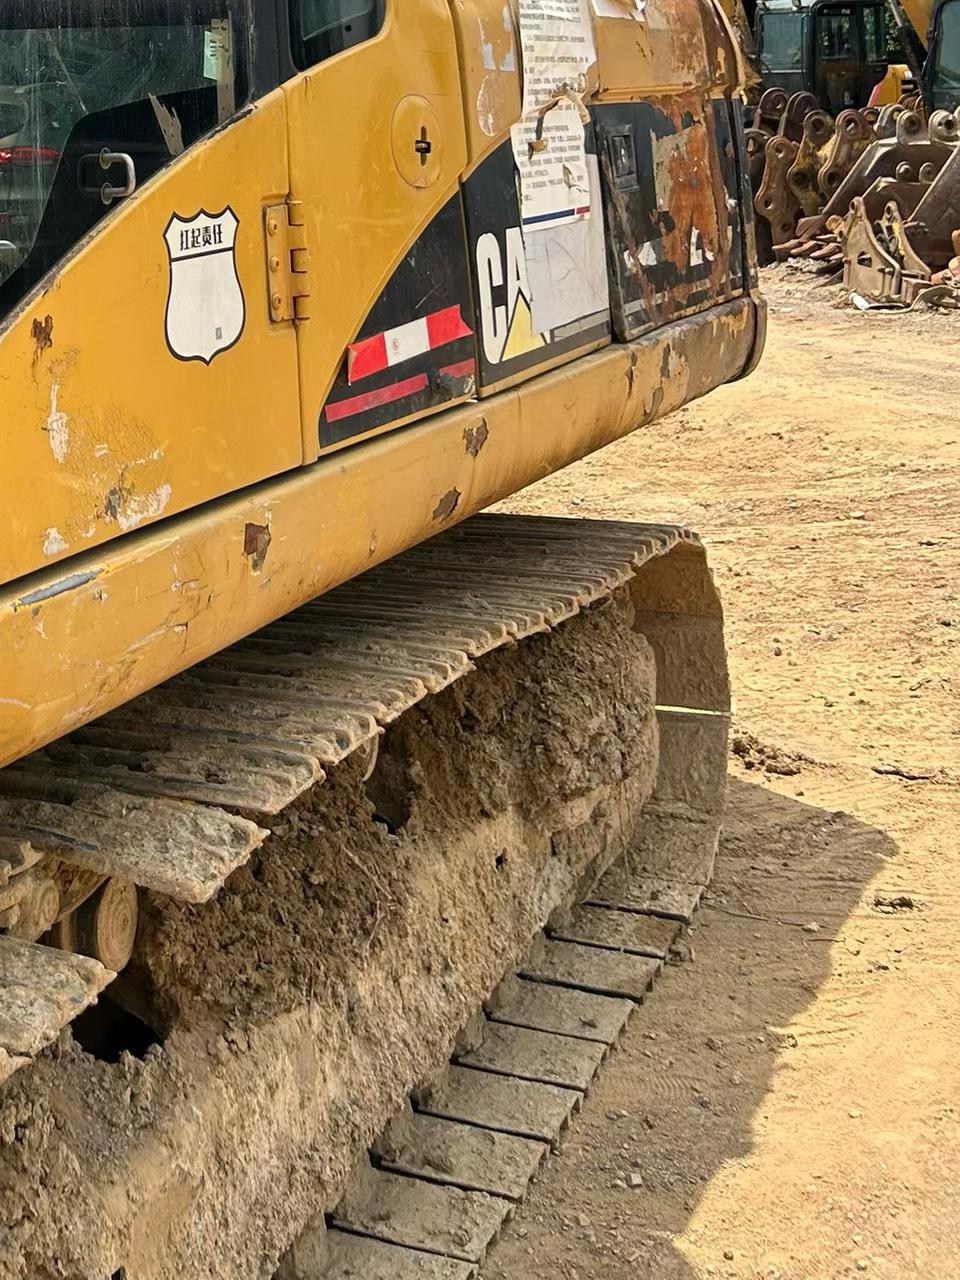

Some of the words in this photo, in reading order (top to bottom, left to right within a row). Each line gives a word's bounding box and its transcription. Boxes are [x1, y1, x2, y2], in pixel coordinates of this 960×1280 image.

[180, 223, 223, 251] 扛起责任
[476, 227, 551, 364] CA
